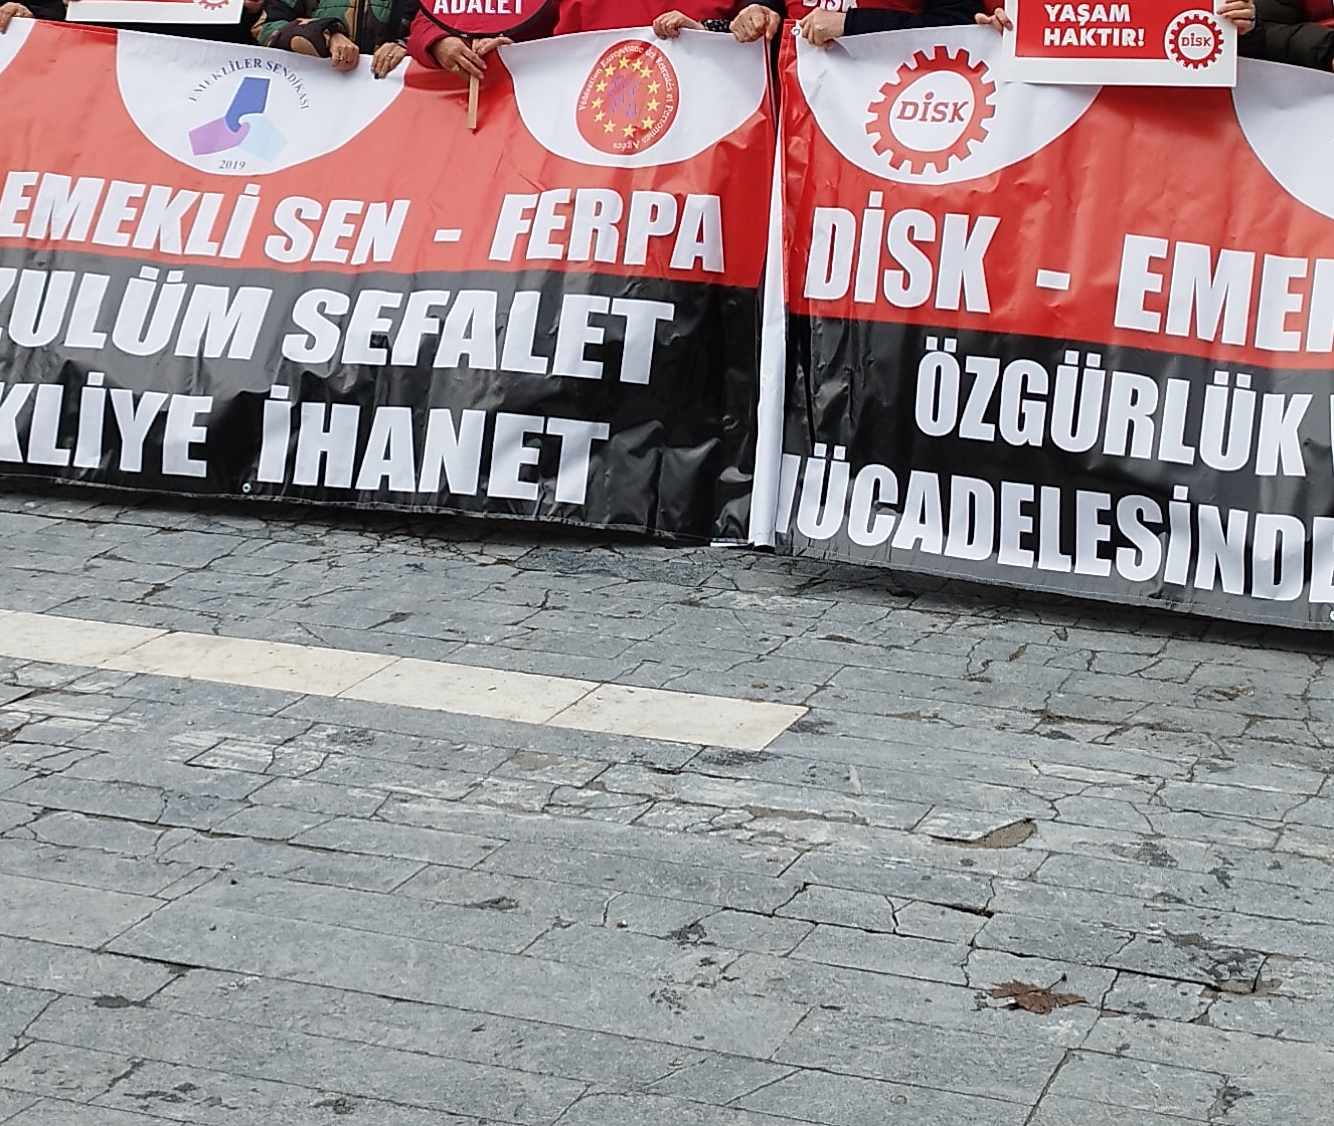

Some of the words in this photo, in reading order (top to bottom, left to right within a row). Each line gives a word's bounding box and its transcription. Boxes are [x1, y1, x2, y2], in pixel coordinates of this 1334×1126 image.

[1043, 27, 1145, 47] HAKTIR!
[1044, 3, 1131, 26] YAŞAM
[1181, 32, 1212, 47] DİSK
[265, 60, 310, 110] SENDİKASI
[896, 90, 970, 124] DİSK
[218, 159, 247, 170] 2019
[264, 196, 411, 265] SEN
[434, 228, 462, 243] -
[488, 187, 725, 274] FERPA
[803, 191, 1001, 314] DİSK
[1034, 268, 1071, 291] -
[281, 288, 676, 386] SEFALET
[914, 336, 1313, 477] ÖZGÜRLÜK
[256, 384, 611, 506] İHANET
